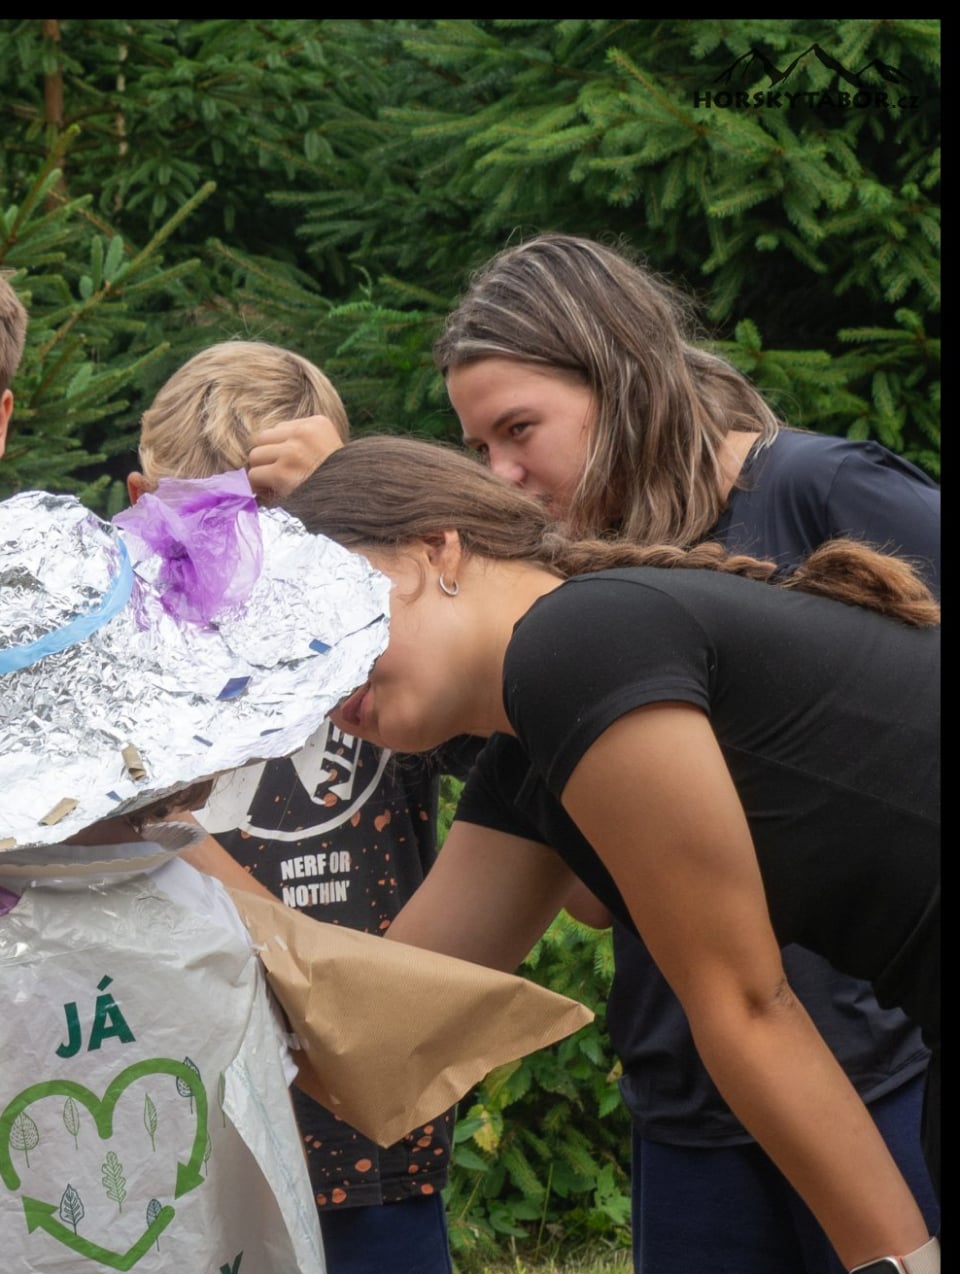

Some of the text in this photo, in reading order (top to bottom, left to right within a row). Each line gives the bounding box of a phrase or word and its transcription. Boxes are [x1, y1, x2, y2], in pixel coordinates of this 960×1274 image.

[280, 851, 351, 881] NERF OR
[282, 880, 350, 908] NOTHIN'
[55, 974, 136, 1059] JÁ
